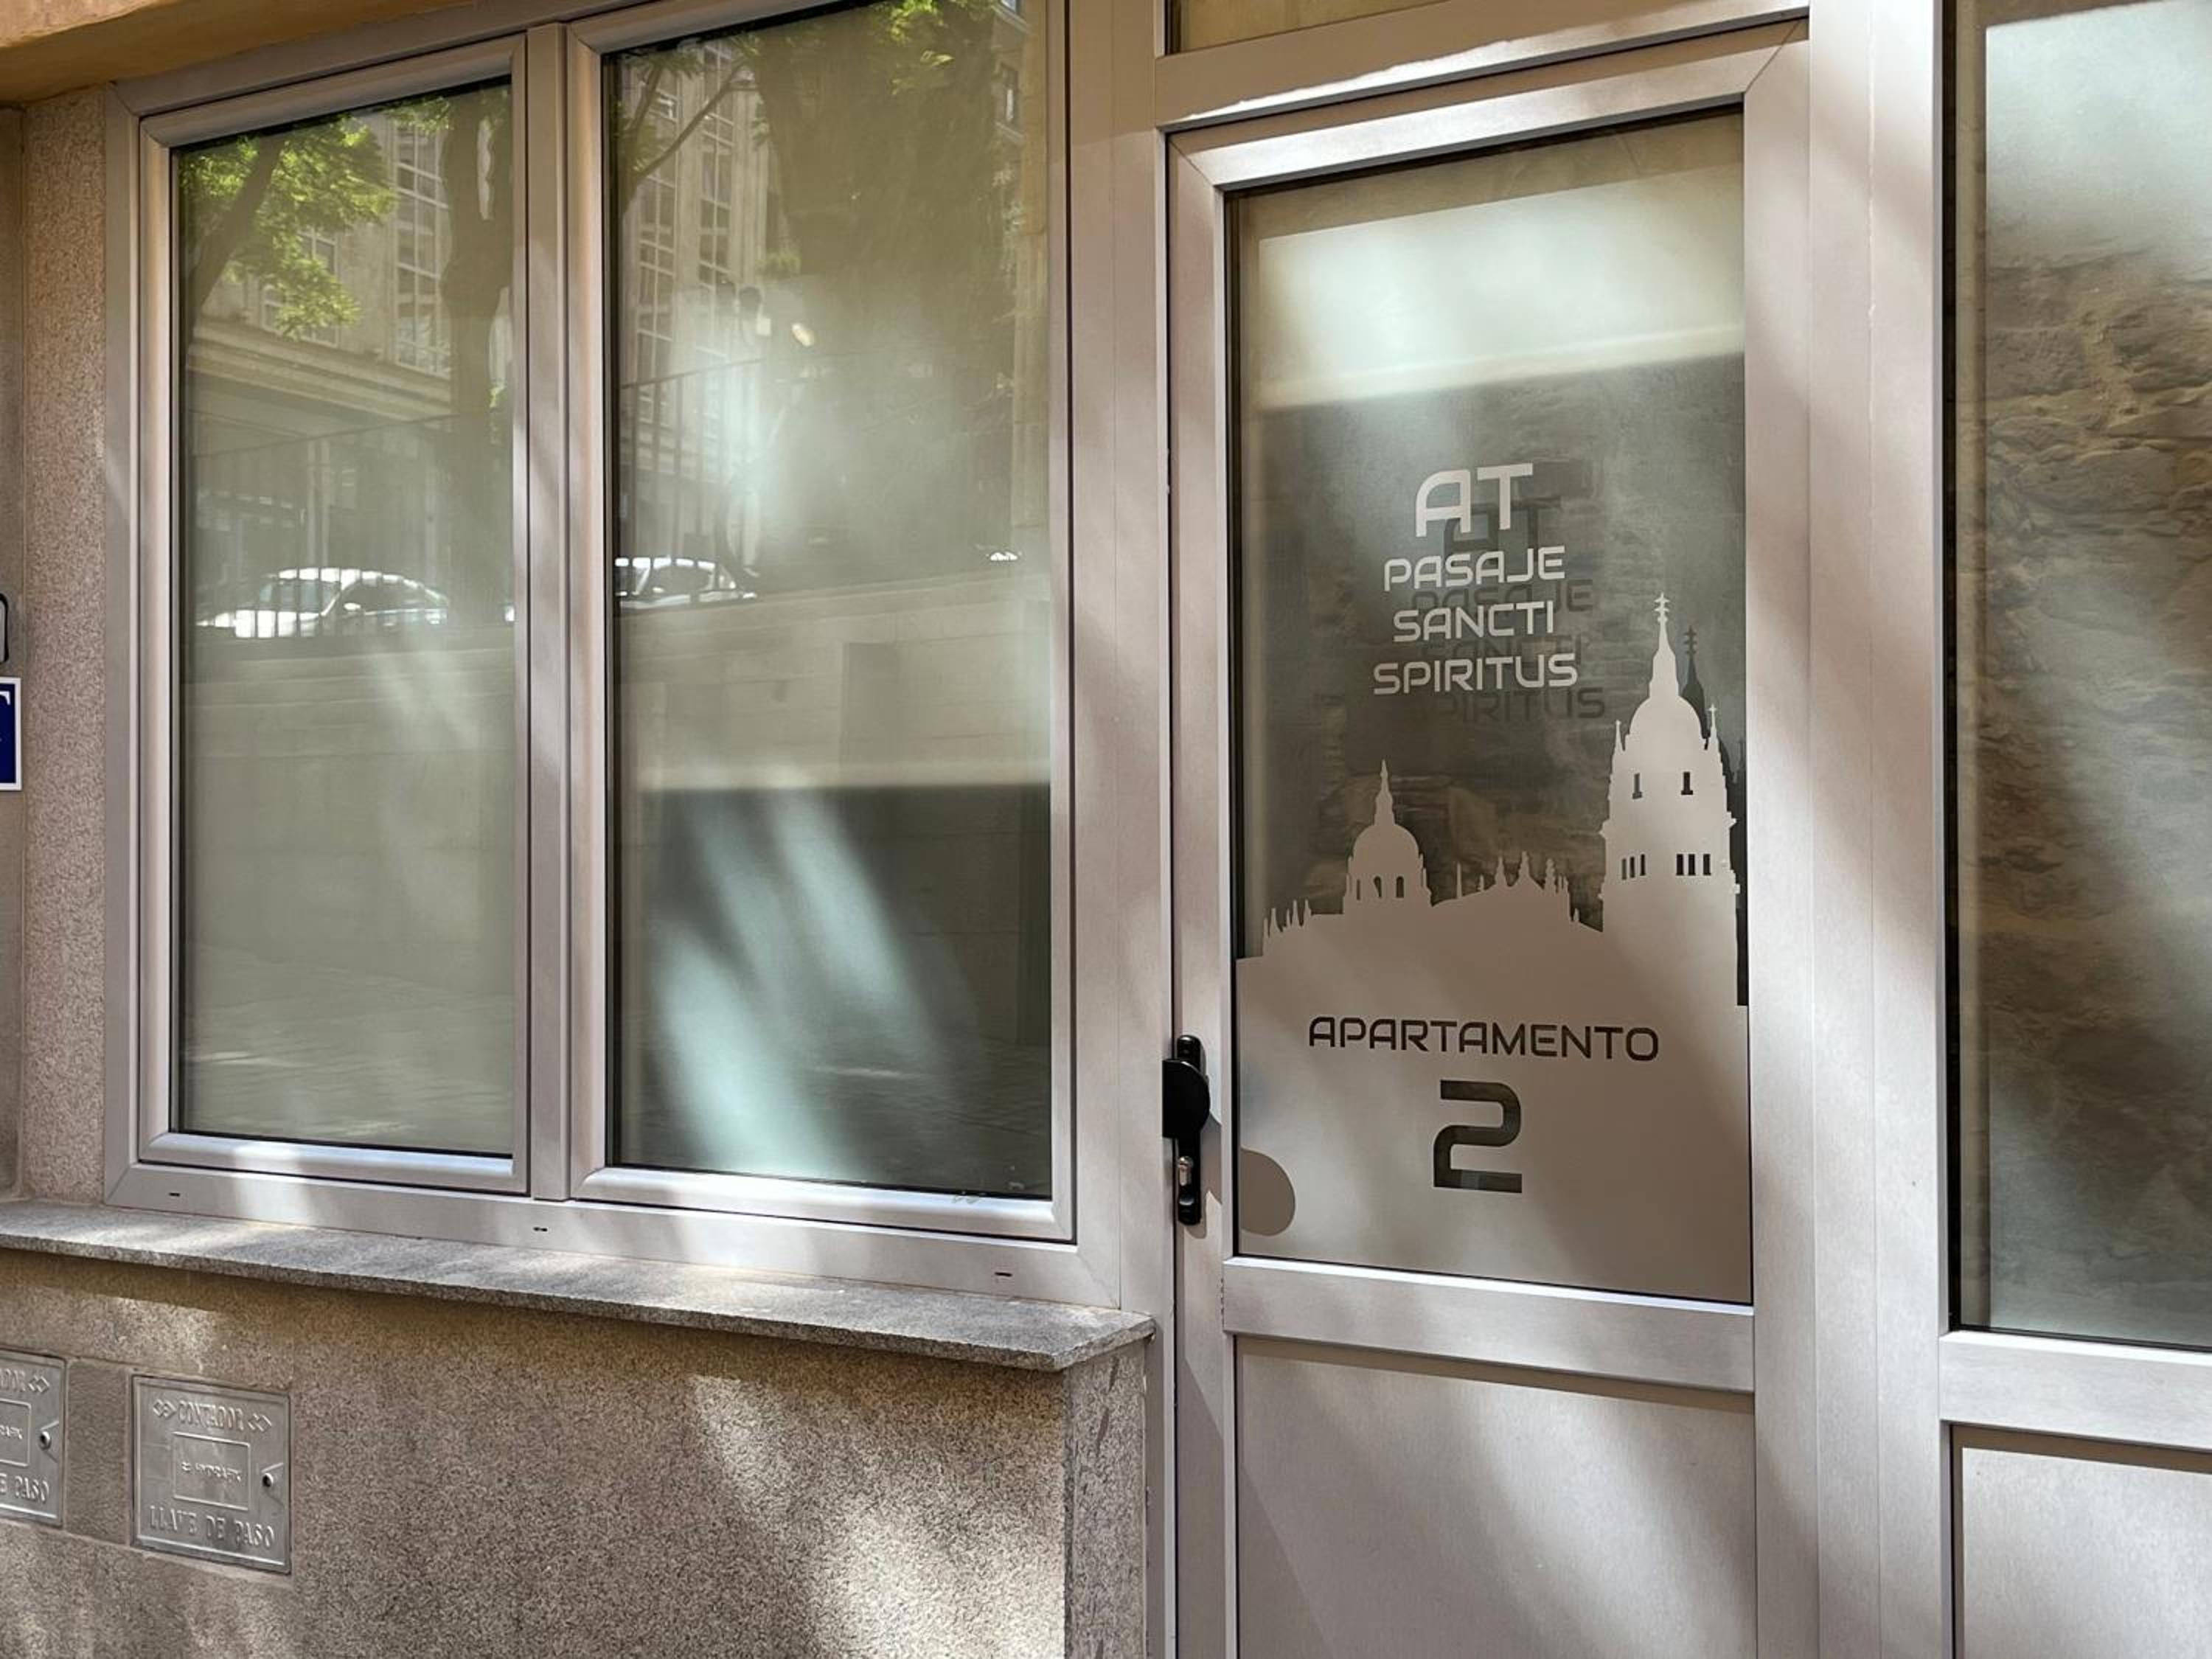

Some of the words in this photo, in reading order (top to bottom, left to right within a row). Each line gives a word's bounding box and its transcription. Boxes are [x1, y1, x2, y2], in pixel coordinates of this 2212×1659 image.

[1416, 462, 1534, 538] AT
[1384, 546, 1565, 591] PASAJE
[1394, 600, 1554, 642] SANCTI
[1374, 653, 1578, 695] SPIRITUS
[1309, 1016, 1659, 1061] APARTAMENTO
[1433, 1079, 1523, 1194] 2
